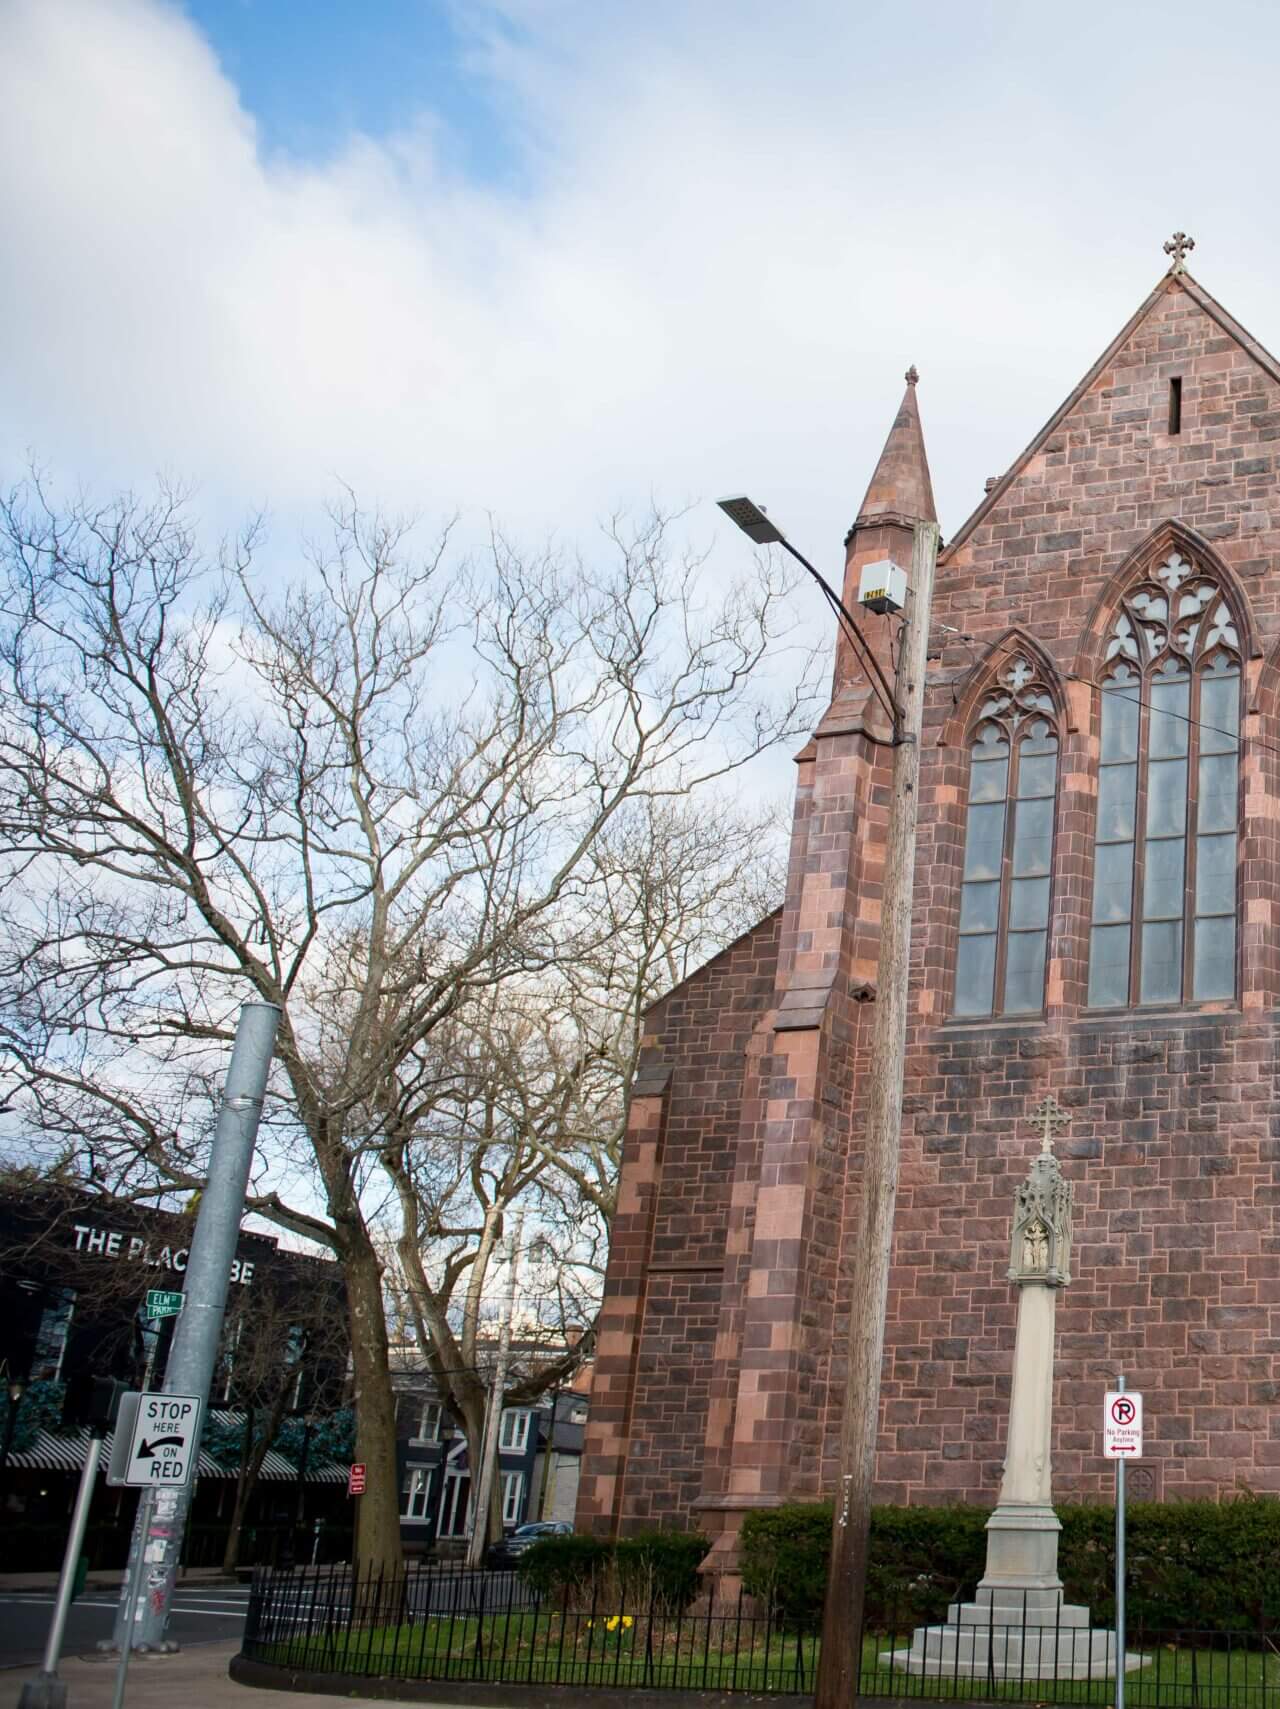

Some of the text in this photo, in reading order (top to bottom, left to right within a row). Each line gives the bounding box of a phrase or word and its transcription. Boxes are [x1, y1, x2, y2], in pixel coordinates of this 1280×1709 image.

[74, 1225, 123, 1258] THE
[127, 1237, 189, 1272] PLAC
[153, 1293, 170, 1305] ELM
[147, 1401, 192, 1420] STOP
[153, 1422, 181, 1433] HERE
[1117, 1428, 1141, 1438] Parking
[162, 1447, 178, 1458] ON
[150, 1461, 183, 1479] RED
